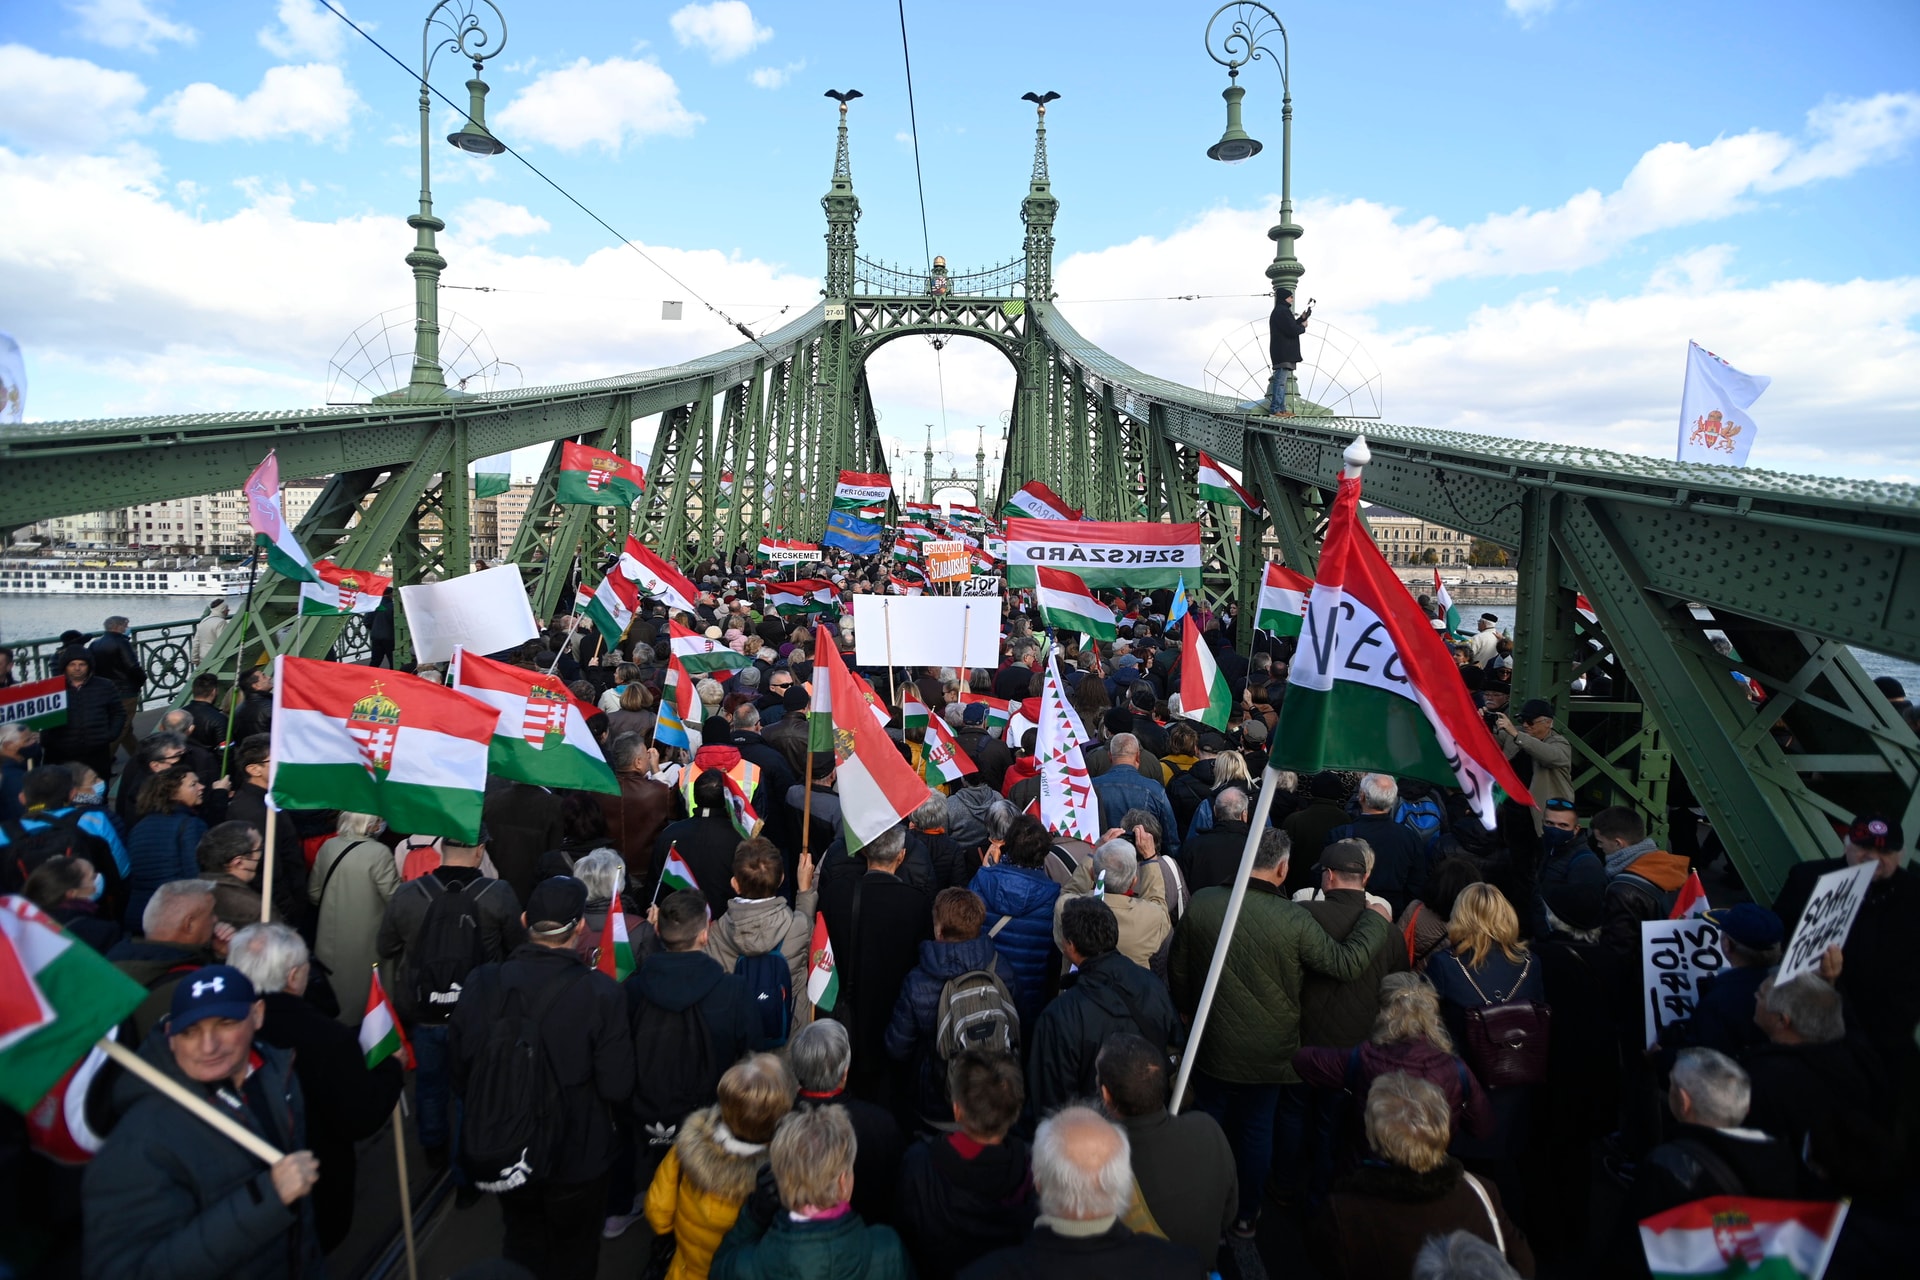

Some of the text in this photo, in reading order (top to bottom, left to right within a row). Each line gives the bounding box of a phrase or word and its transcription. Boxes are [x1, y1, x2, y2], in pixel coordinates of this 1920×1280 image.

[771, 552, 819, 560] KECSKEMÉT
[931, 553, 969, 580] SZABADSÁG
[964, 577, 996, 591] STOP
[1684, 924, 1724, 979] SO
